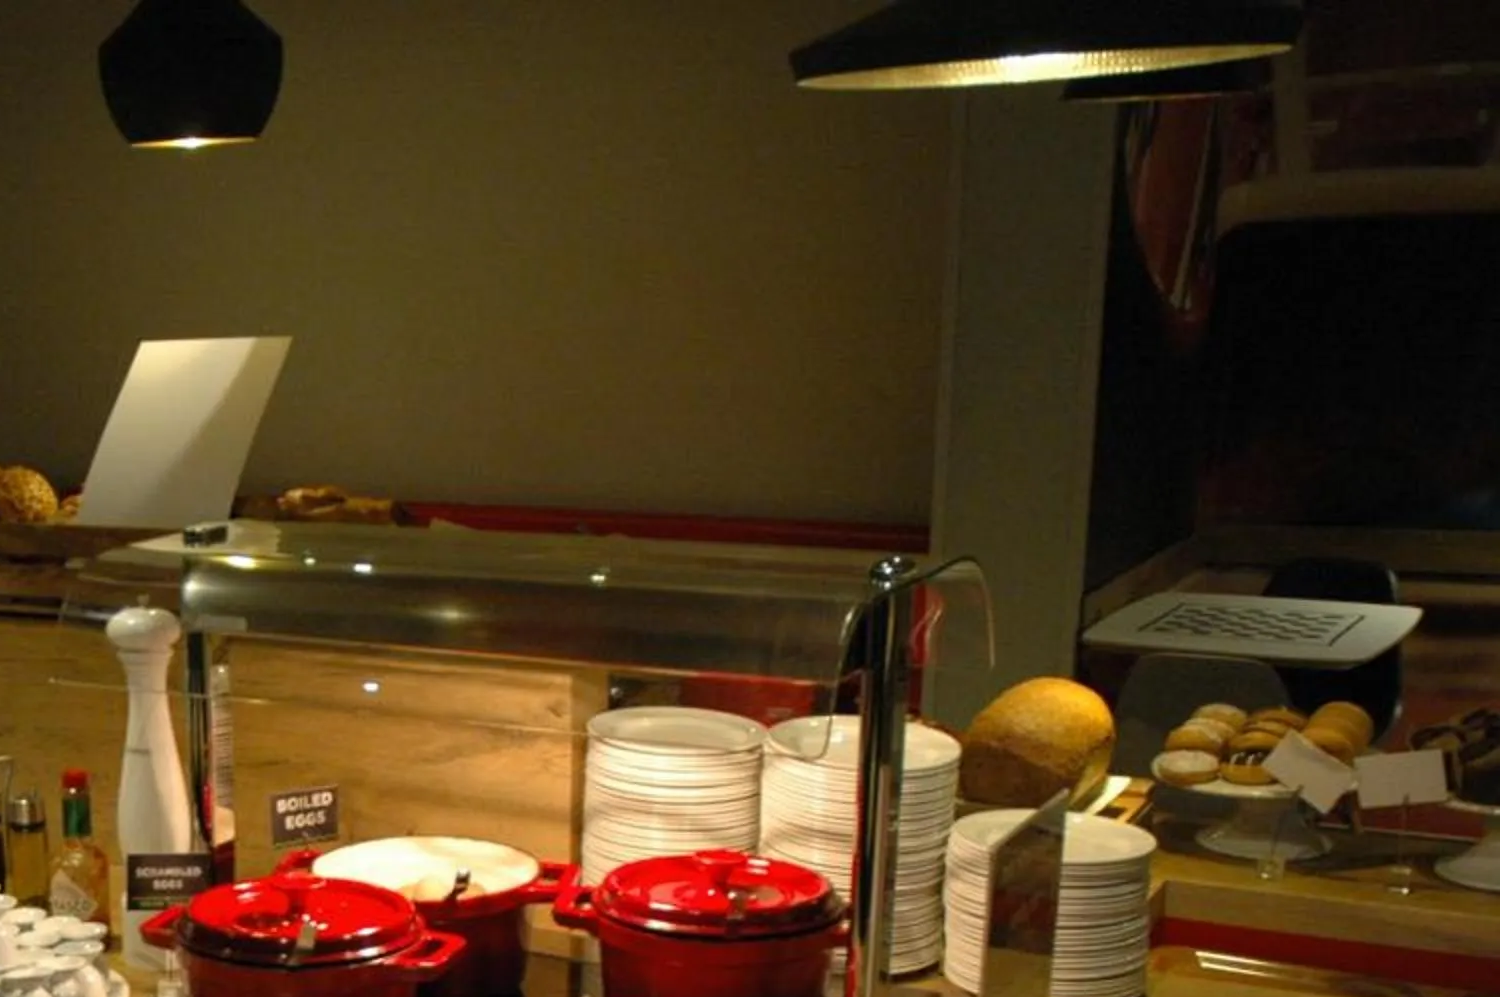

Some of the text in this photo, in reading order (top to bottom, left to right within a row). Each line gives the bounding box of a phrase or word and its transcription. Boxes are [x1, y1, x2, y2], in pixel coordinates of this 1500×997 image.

[276, 791, 333, 815] BOILED
[284, 810, 326, 831] EGGS
[135, 865, 203, 879] SCRAMBLED
[152, 879, 184, 891] EGGS
